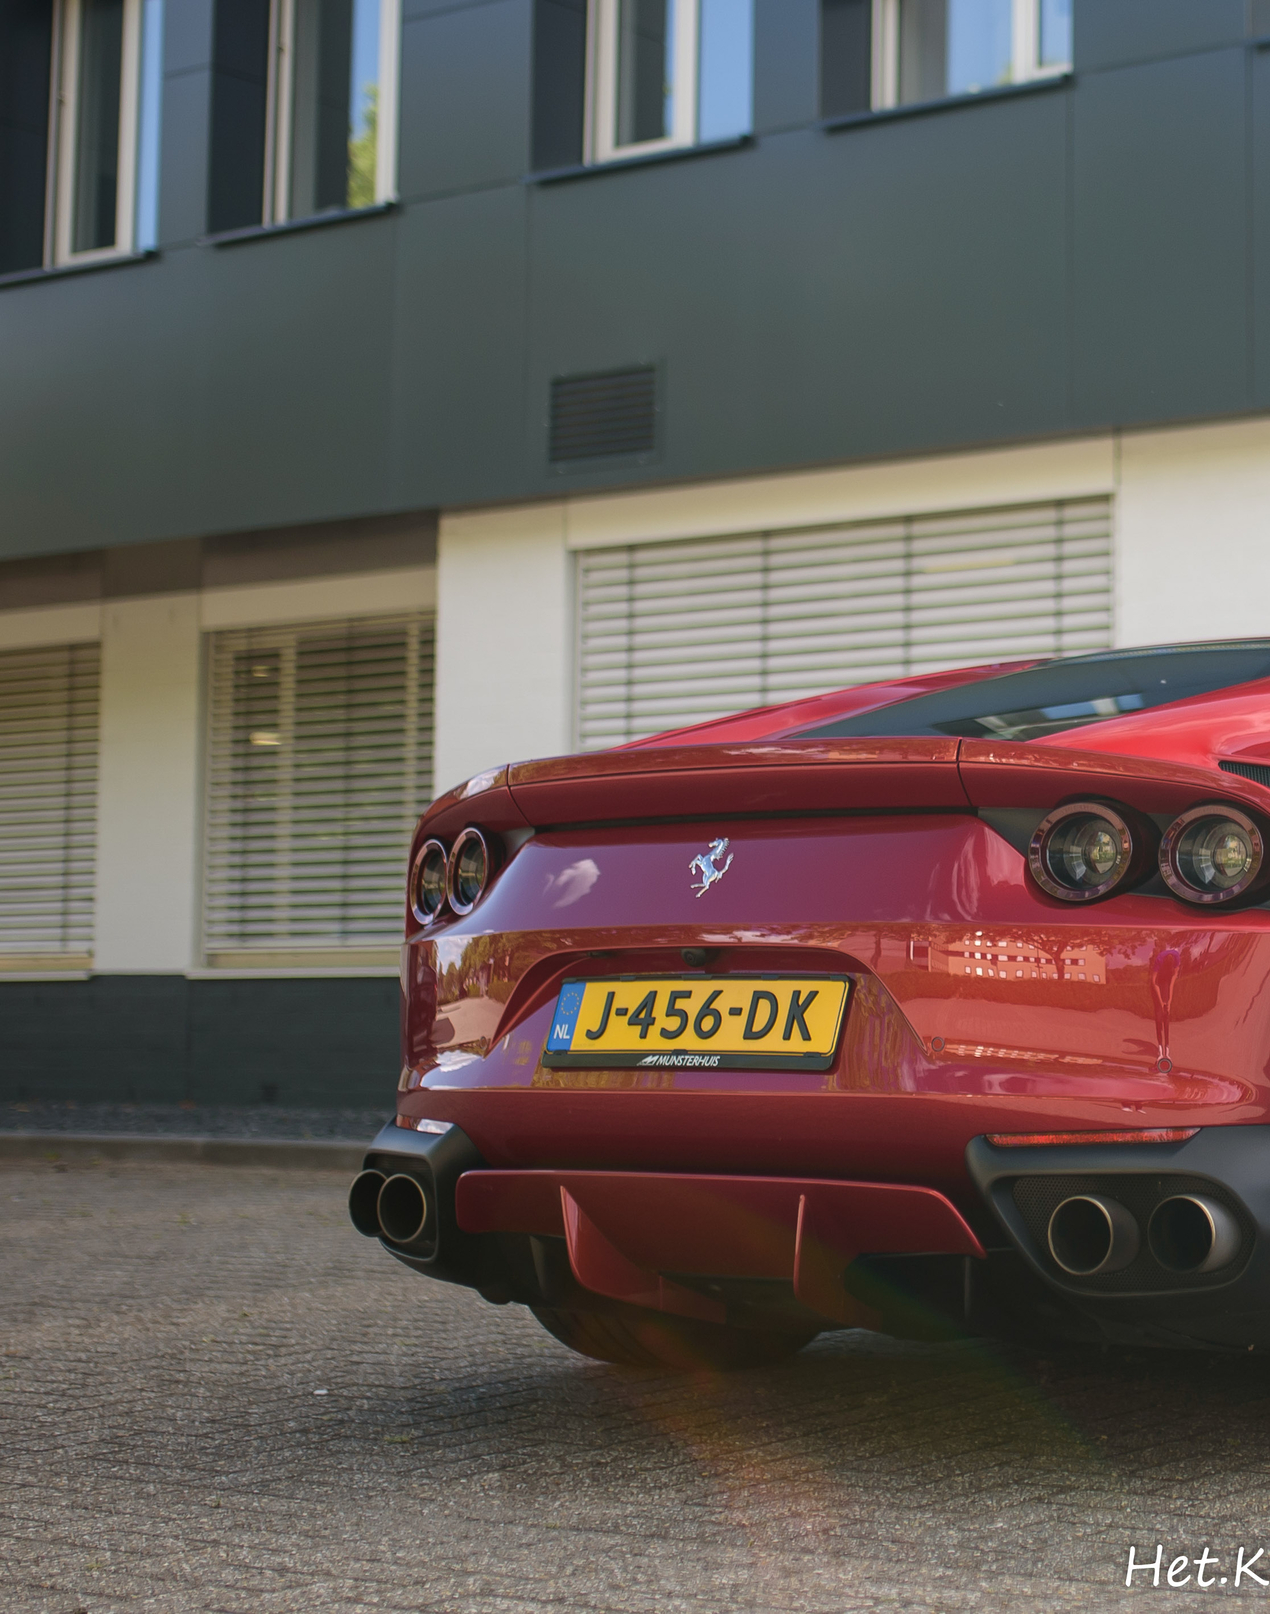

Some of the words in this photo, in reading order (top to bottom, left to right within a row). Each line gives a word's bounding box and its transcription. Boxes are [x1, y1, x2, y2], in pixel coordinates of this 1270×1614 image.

[585, 990, 819, 1040] J-456-DK
[554, 1024, 570, 1040] NL
[656, 1055, 720, 1067] MUNSTERHUIS
